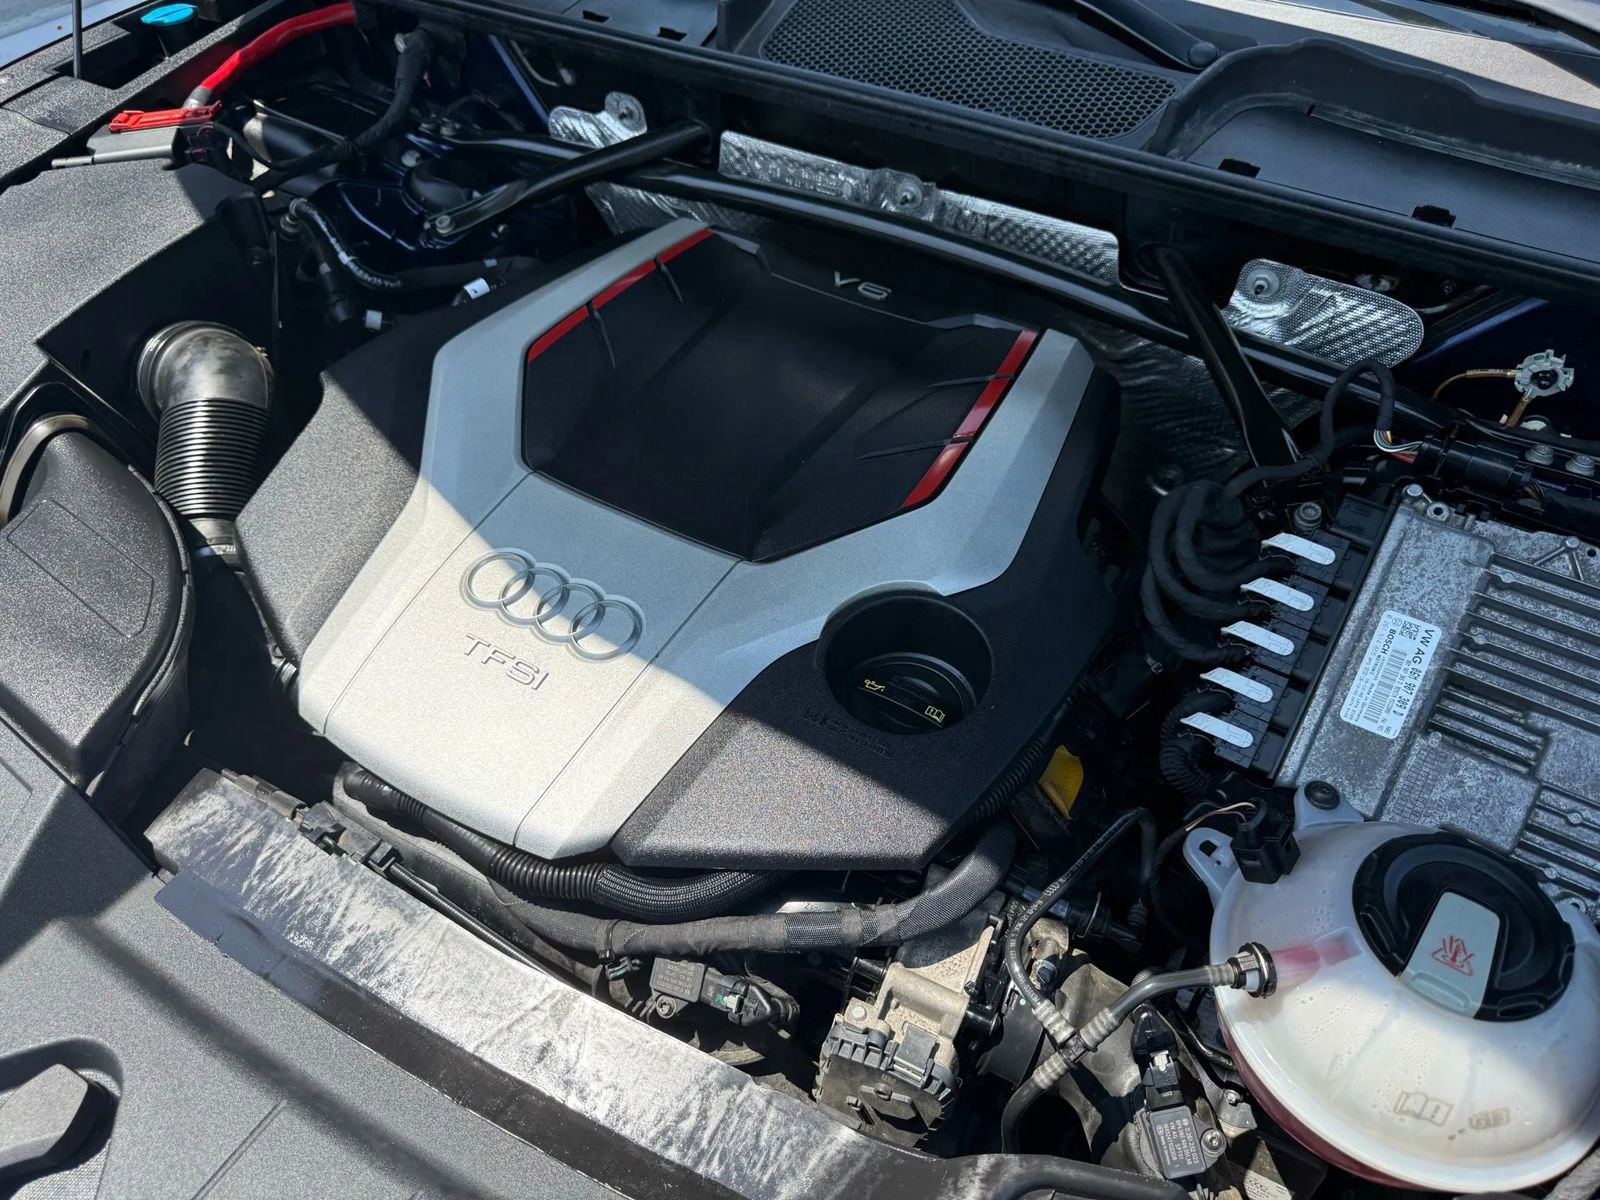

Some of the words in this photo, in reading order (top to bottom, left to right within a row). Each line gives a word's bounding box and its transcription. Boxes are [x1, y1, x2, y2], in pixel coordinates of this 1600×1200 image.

[834, 270, 893, 301] V6
[1380, 628, 1396, 655] BOSCH
[1420, 628, 1435, 647] VW
[463, 633, 550, 691] TFSI
[1412, 647, 1426, 665] AG
[1402, 681, 1416, 695] 907
[1395, 696, 1410, 710] 309
[1169, 1121, 1175, 1130] VW
[1171, 1130, 1178, 1139] AG
